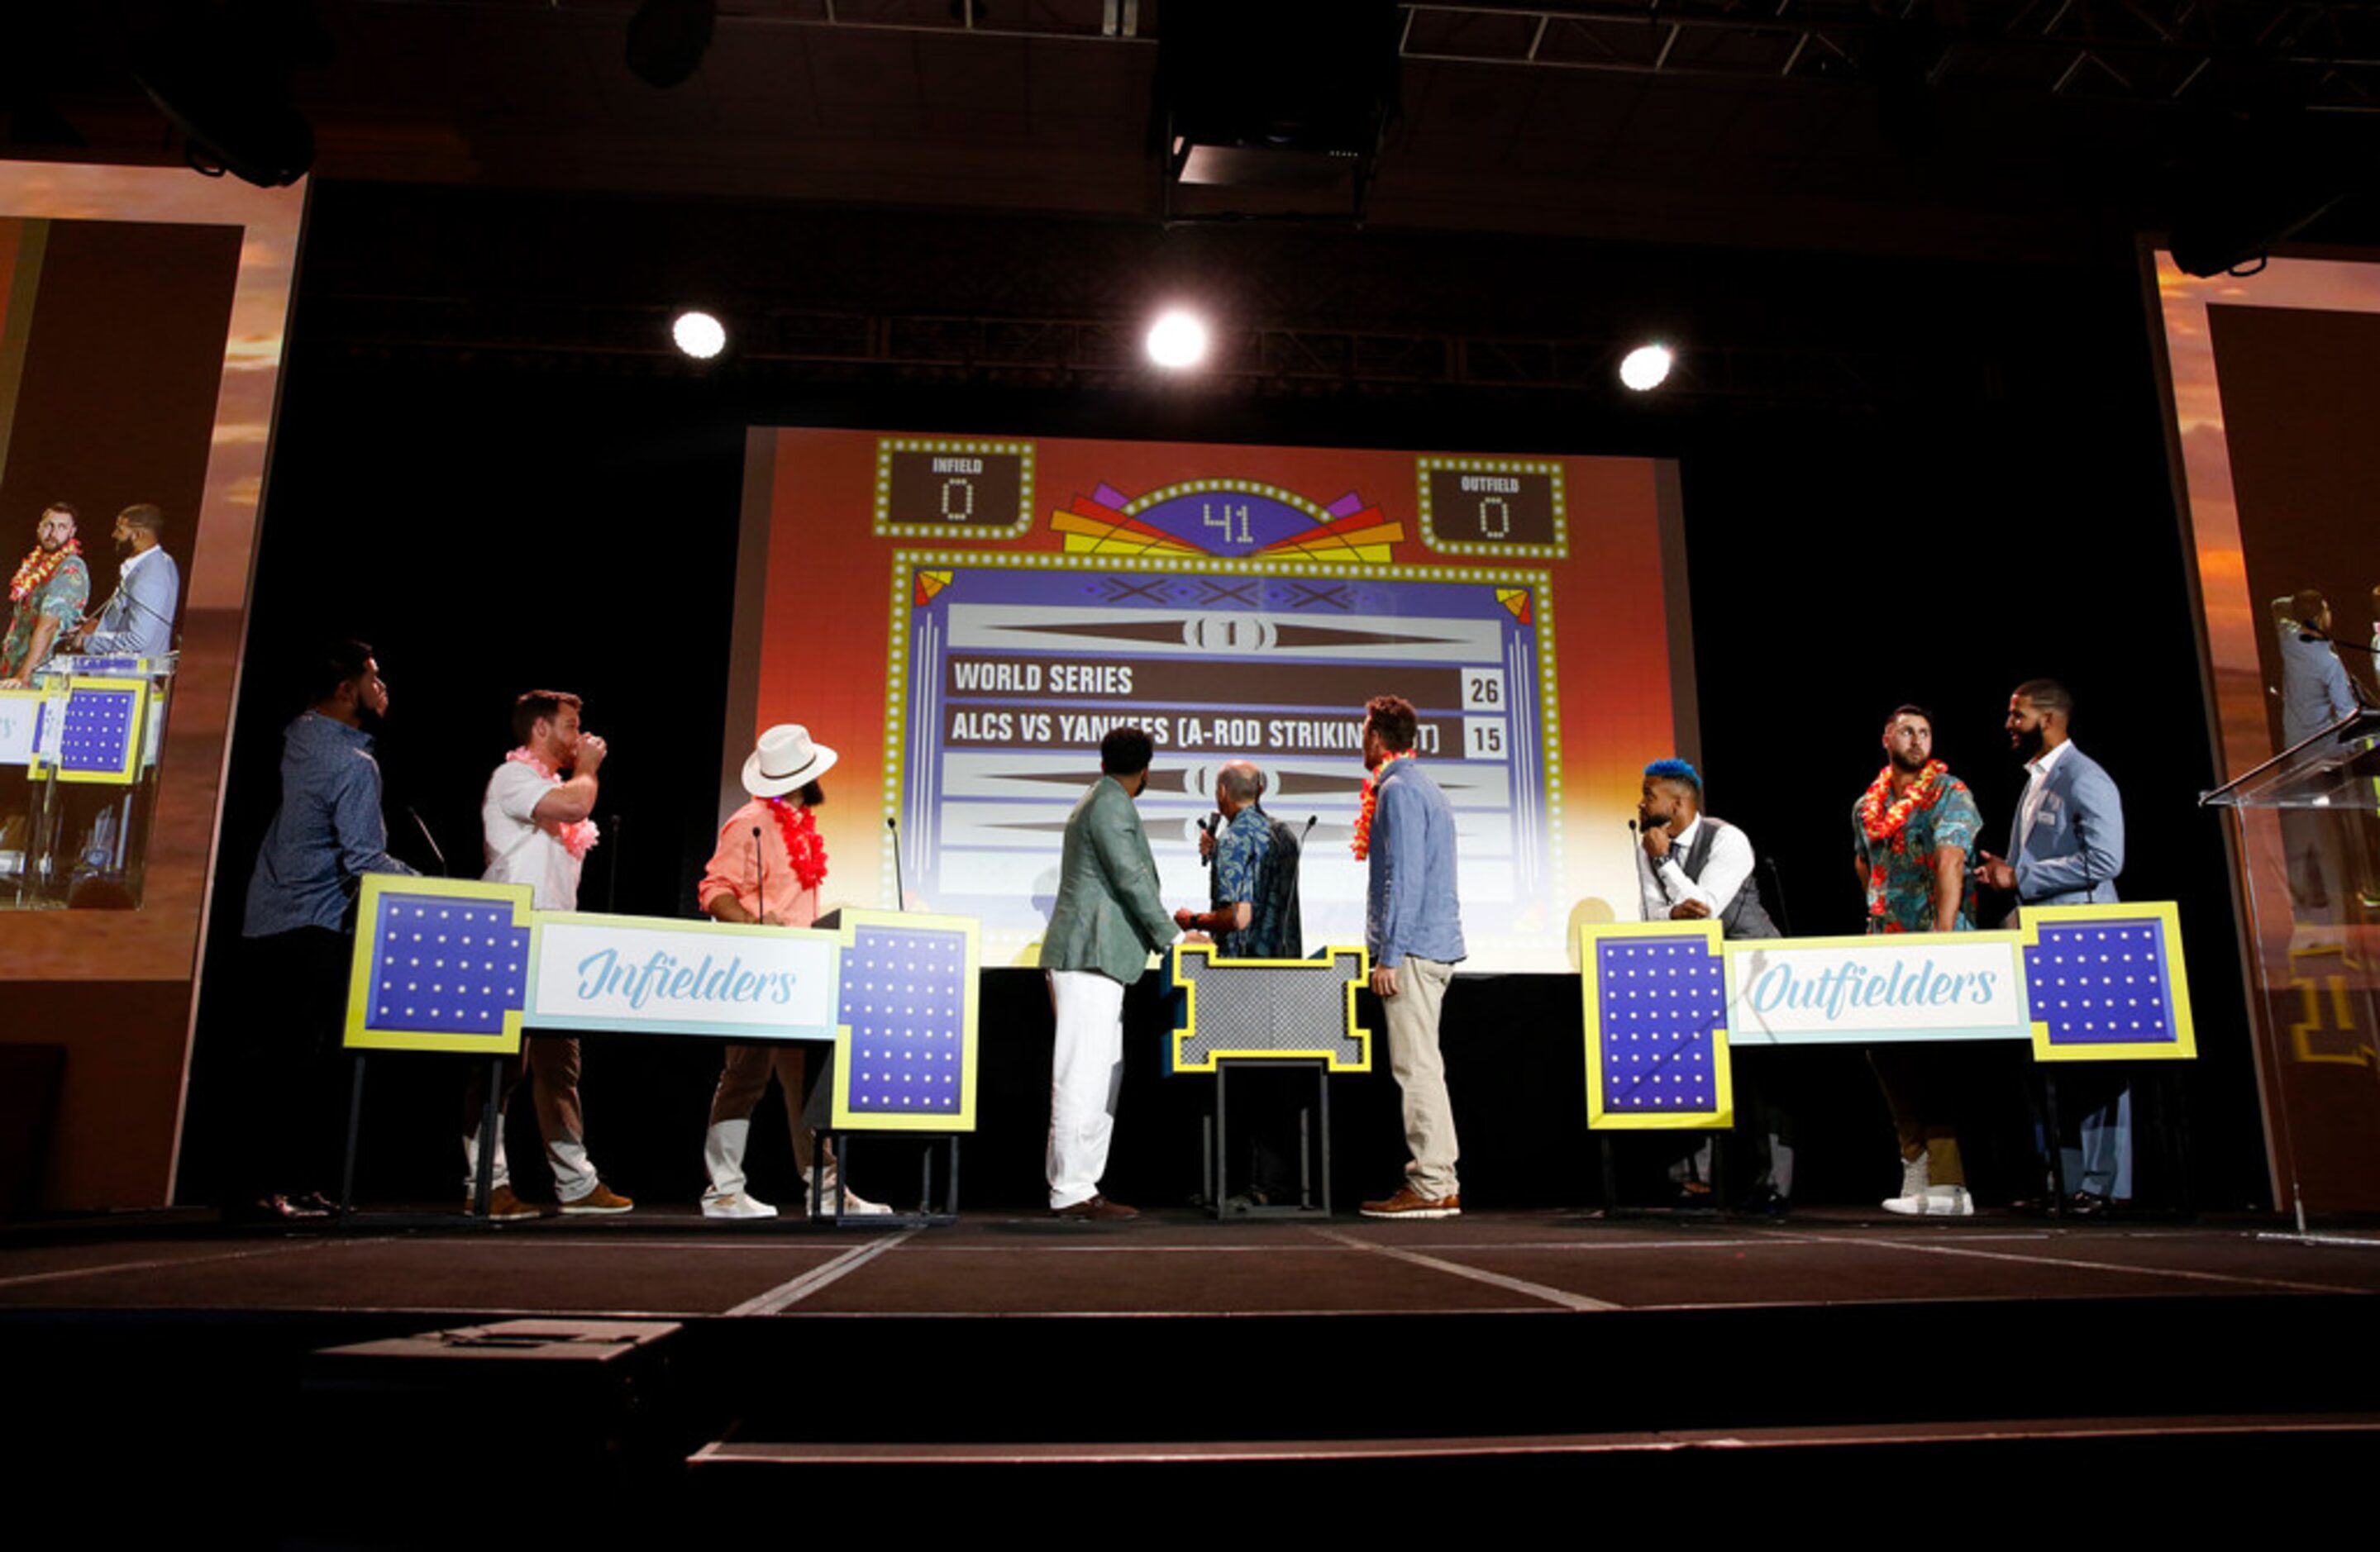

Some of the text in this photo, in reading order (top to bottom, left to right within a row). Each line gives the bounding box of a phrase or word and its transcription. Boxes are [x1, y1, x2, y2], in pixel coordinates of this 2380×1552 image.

[932, 457, 982, 474] INFIELD
[1461, 475, 1519, 493] OUTFIELD
[942, 478, 974, 521] 0
[1479, 497, 1510, 539] 0
[1204, 504, 1253, 543] 41
[954, 662, 1133, 694] WORLD SERIES
[1471, 678, 1500, 703] 26
[952, 712, 1013, 741] ALCS
[1019, 714, 1052, 742] VS
[1269, 720, 1364, 750] STRIKIN
[1473, 727, 1501, 752] 15
[578, 948, 796, 1010] Infielders
[1754, 959, 1997, 1021] Outfielders
